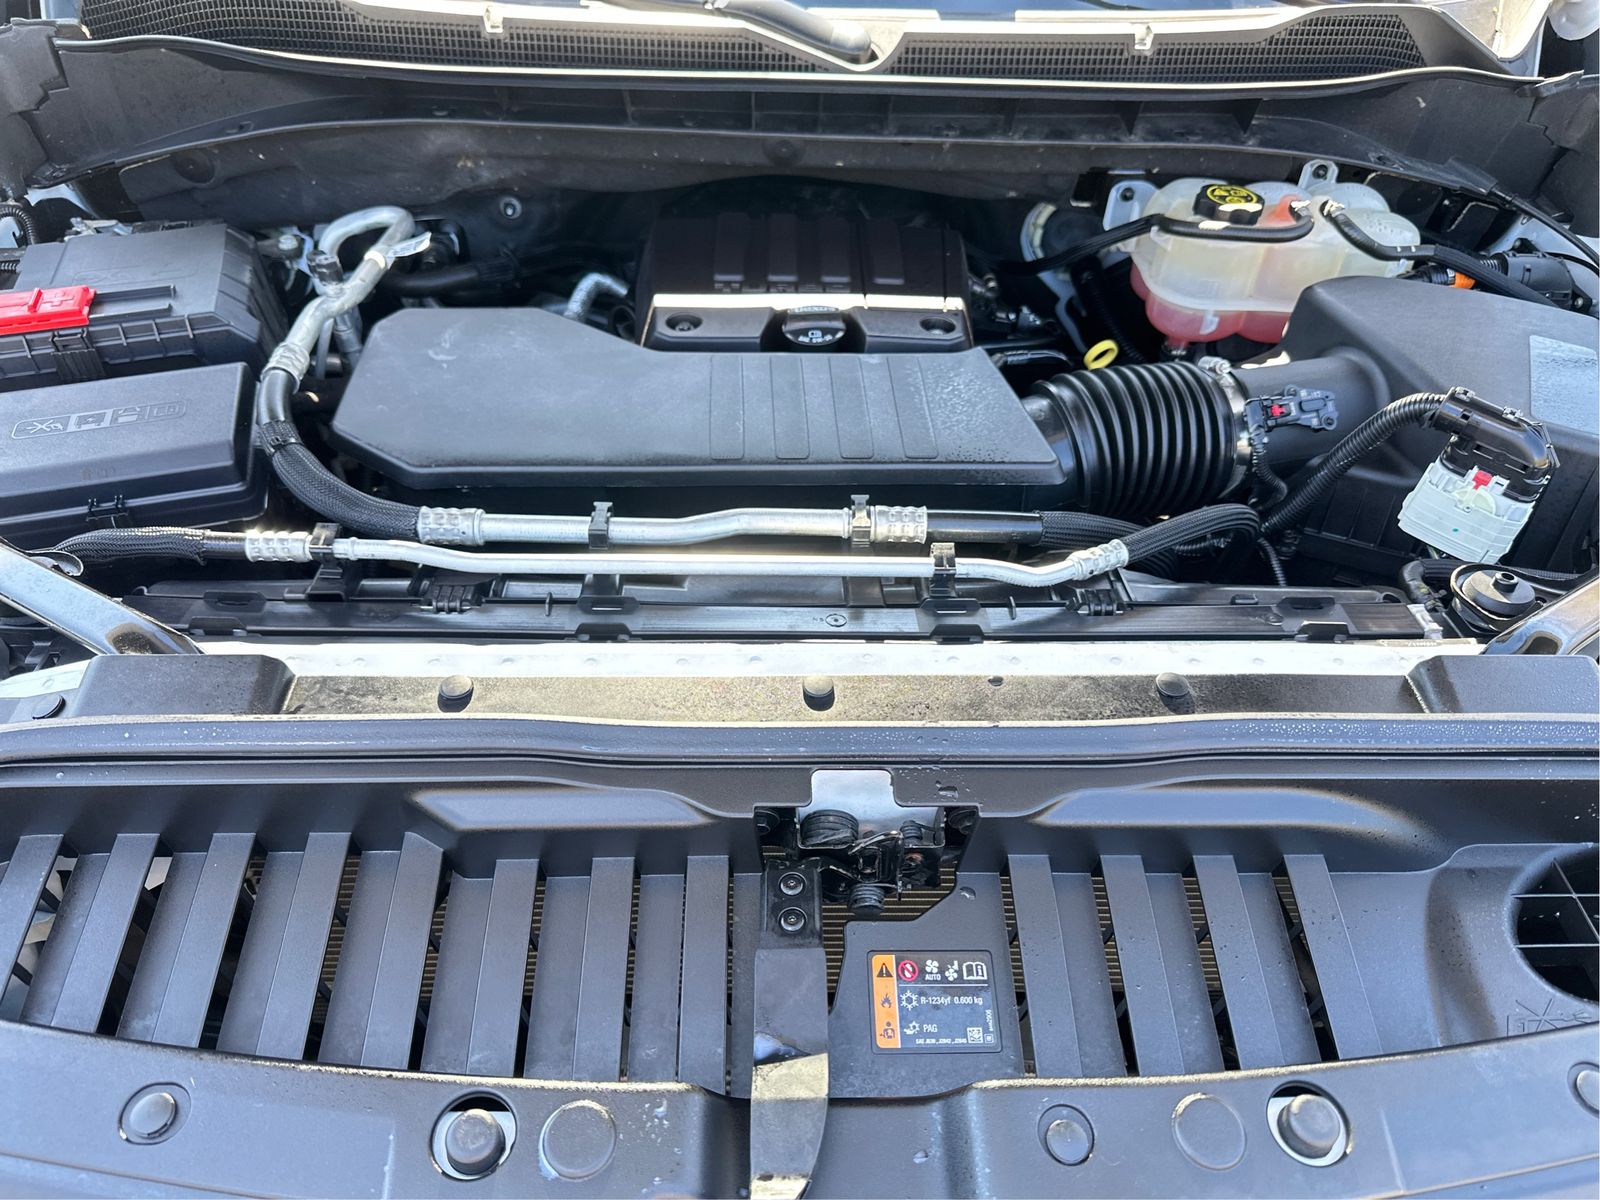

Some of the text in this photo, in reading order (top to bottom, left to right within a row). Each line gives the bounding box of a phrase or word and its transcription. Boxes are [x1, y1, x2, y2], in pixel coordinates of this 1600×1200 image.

[925, 973, 942, 981] AUTO
[920, 995, 983, 1006] R-1234yf 0.600 kg
[923, 1024, 938, 1033] PAG
